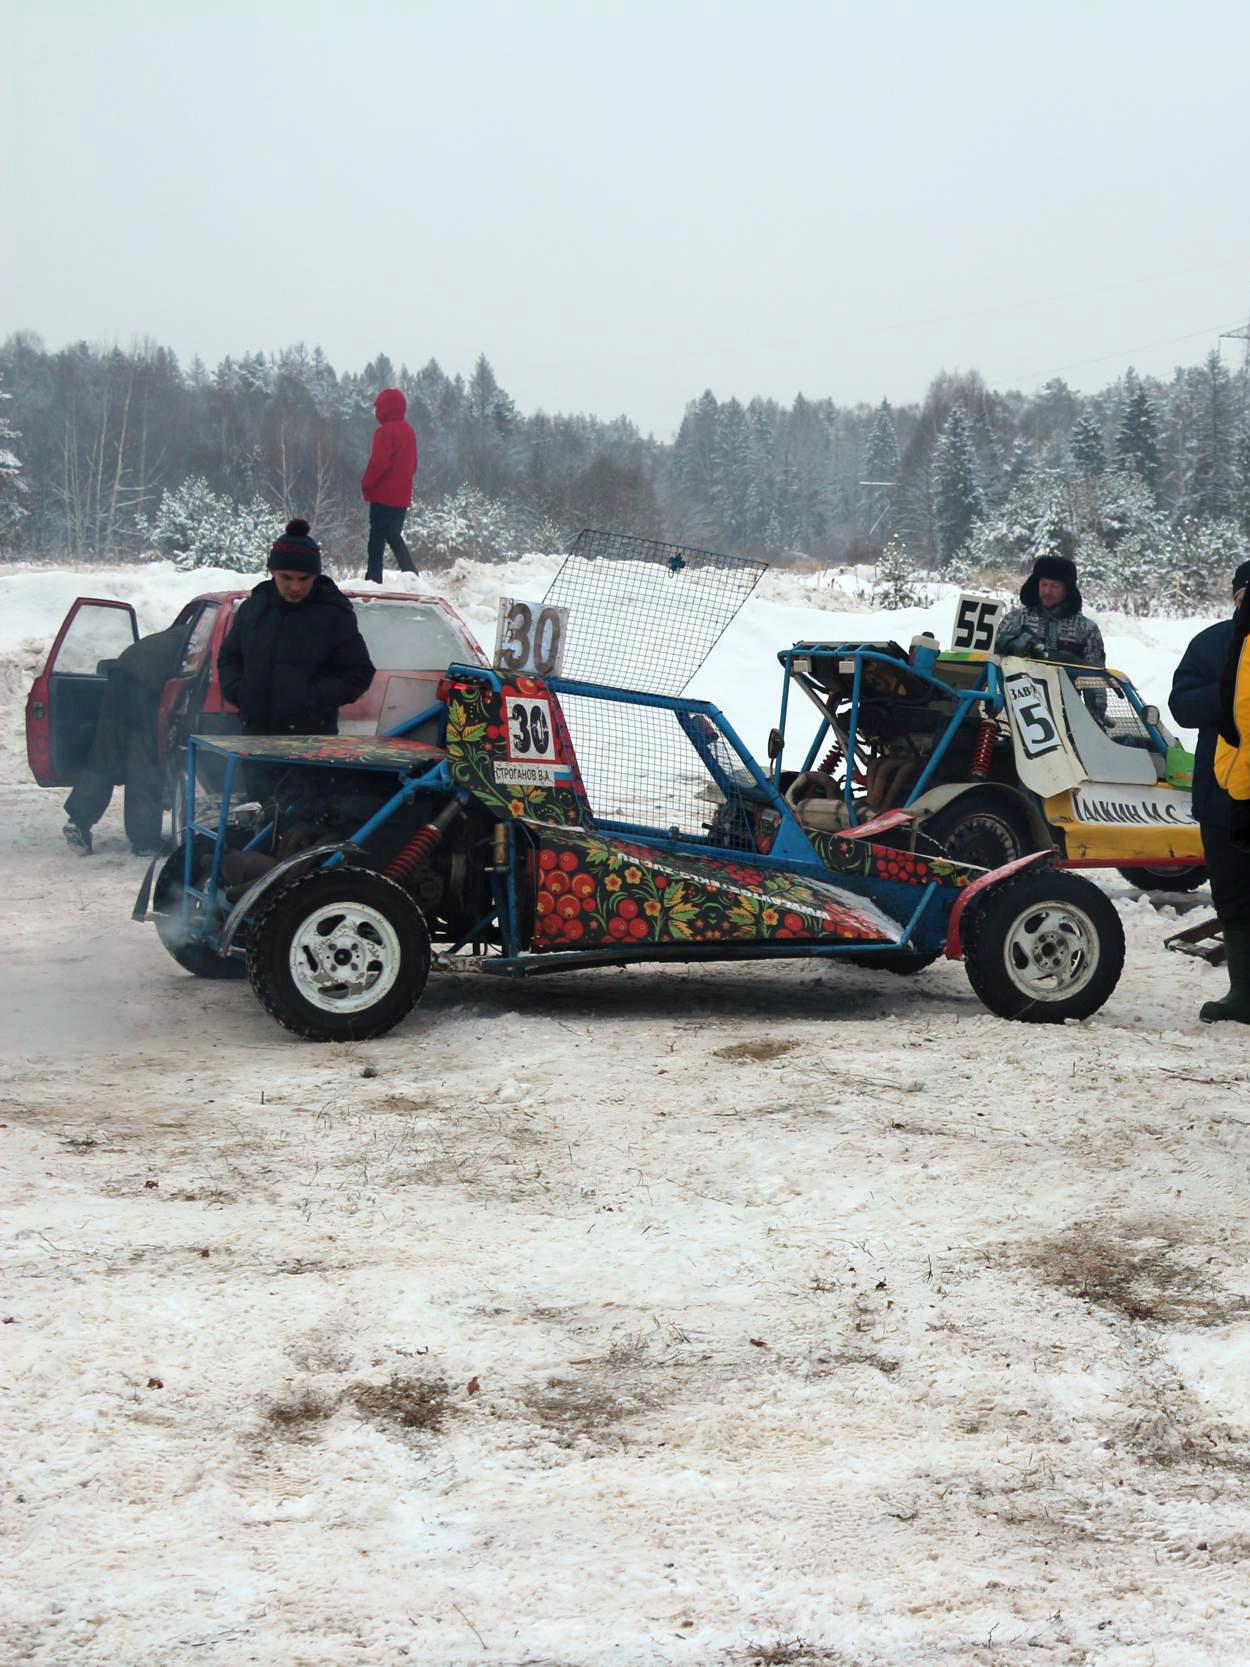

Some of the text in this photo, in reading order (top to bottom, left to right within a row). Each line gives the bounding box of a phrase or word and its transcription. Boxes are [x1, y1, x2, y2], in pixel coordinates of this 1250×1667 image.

[500, 602, 561, 675] 30
[954, 600, 999, 651] 55
[511, 703, 550, 754] 30
[1019, 703, 1055, 744] 5
[495, 767, 537, 781] СТРОГАНОВ
